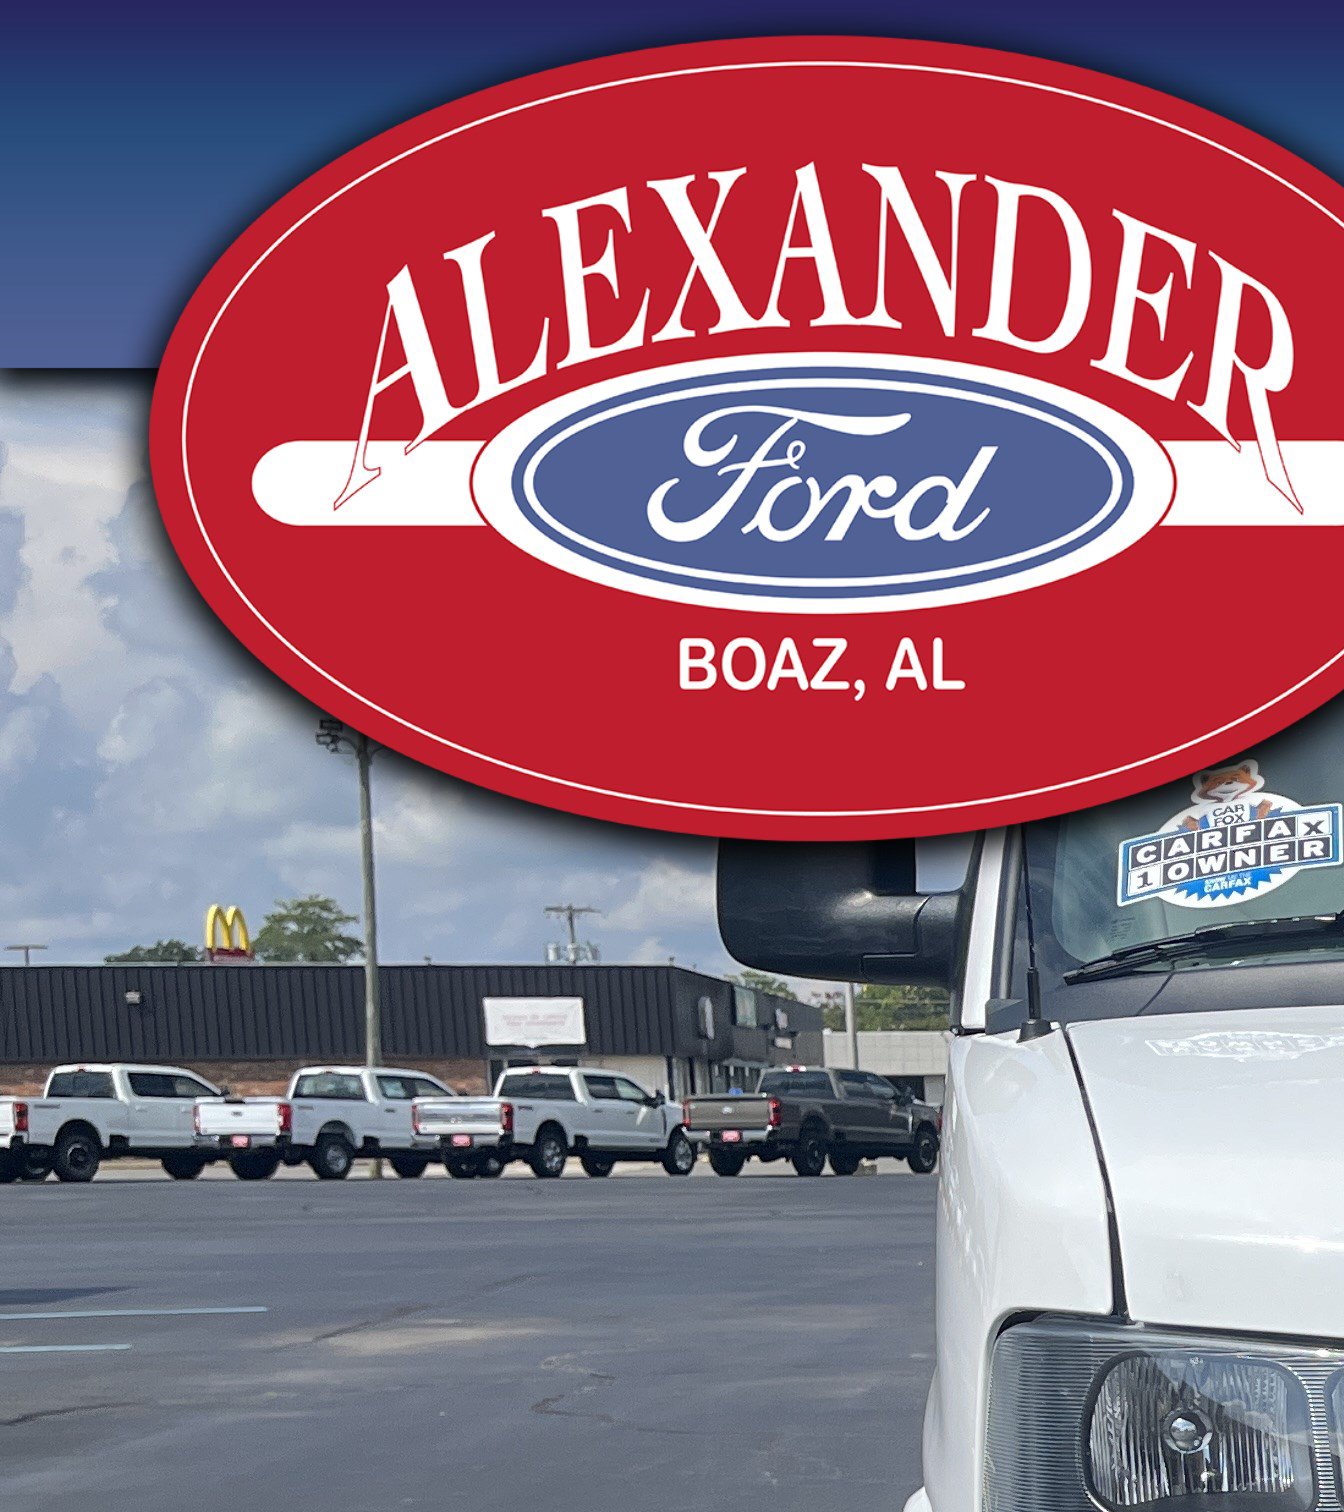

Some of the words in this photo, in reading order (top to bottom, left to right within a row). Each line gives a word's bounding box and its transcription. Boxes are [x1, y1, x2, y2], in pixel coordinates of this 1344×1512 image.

[1212, 804, 1245, 818] CAR
[1213, 812, 1246, 828] FOX
[1136, 819, 1325, 864] CARFAX
[1137, 871, 1153, 889] 1
[1167, 840, 1325, 881] OWNER
[1204, 877, 1252, 893] CARFAX
